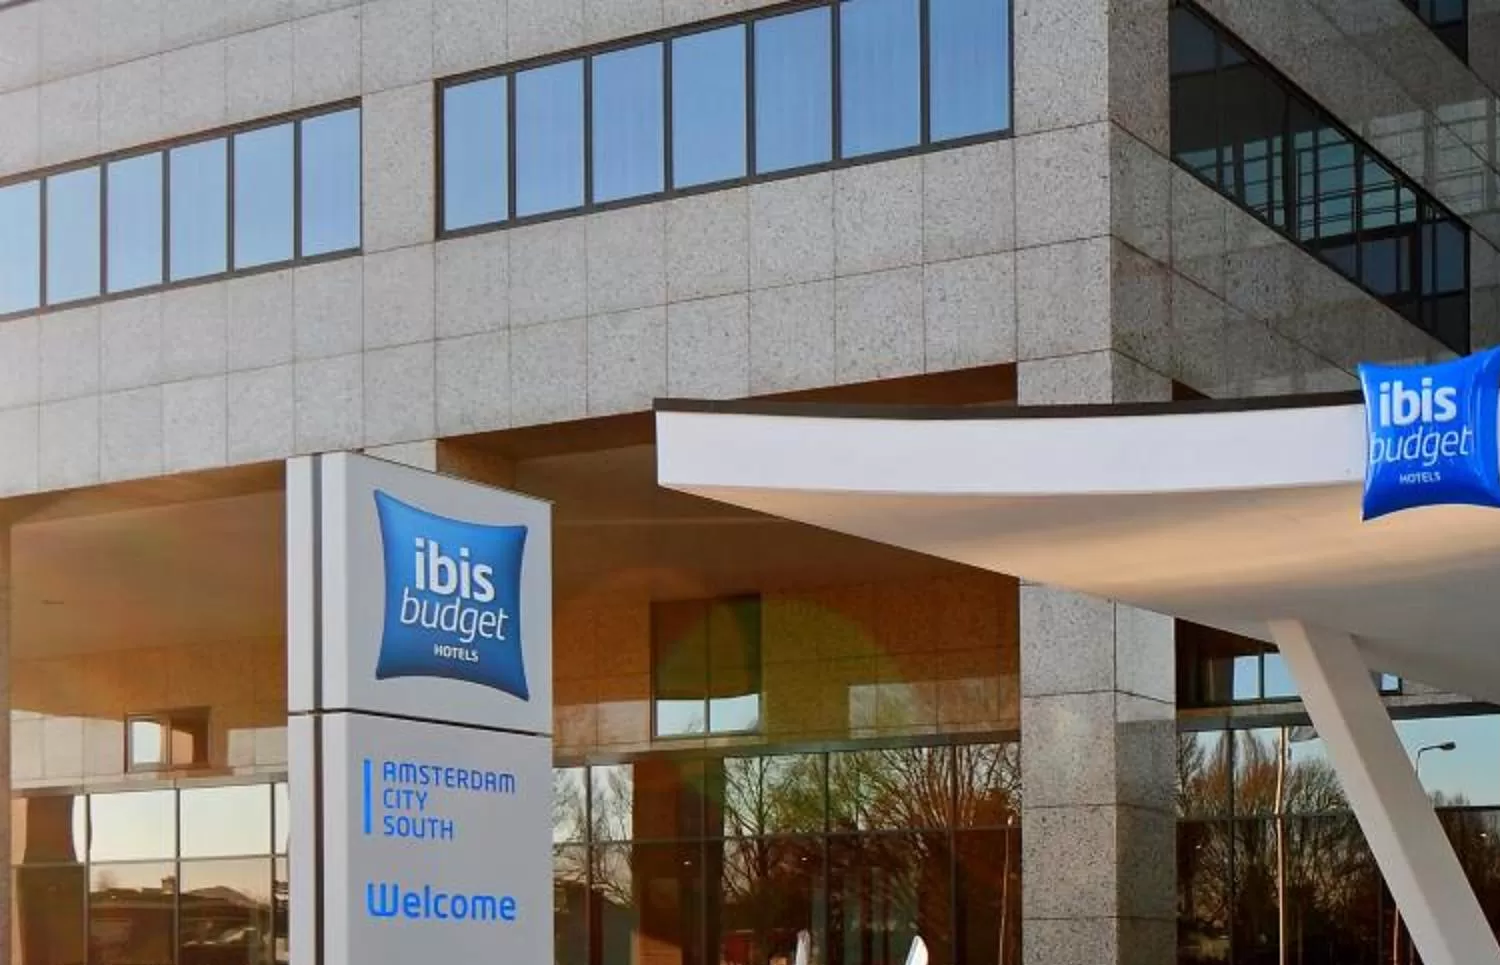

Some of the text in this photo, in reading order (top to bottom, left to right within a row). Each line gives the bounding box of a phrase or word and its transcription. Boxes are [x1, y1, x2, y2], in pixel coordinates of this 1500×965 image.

[1379, 377, 1457, 427] ibis
[1370, 425, 1473, 468] budget
[1399, 471, 1442, 485] HOTELS
[415, 537, 495, 603] ibis
[400, 587, 509, 643] budget
[433, 643, 479, 663] HOTELS
[383, 761, 516, 794] AMSTERDAM
[383, 788, 428, 811] CITY
[383, 815, 454, 841] SOUTH
[366, 883, 517, 922] Welcome
